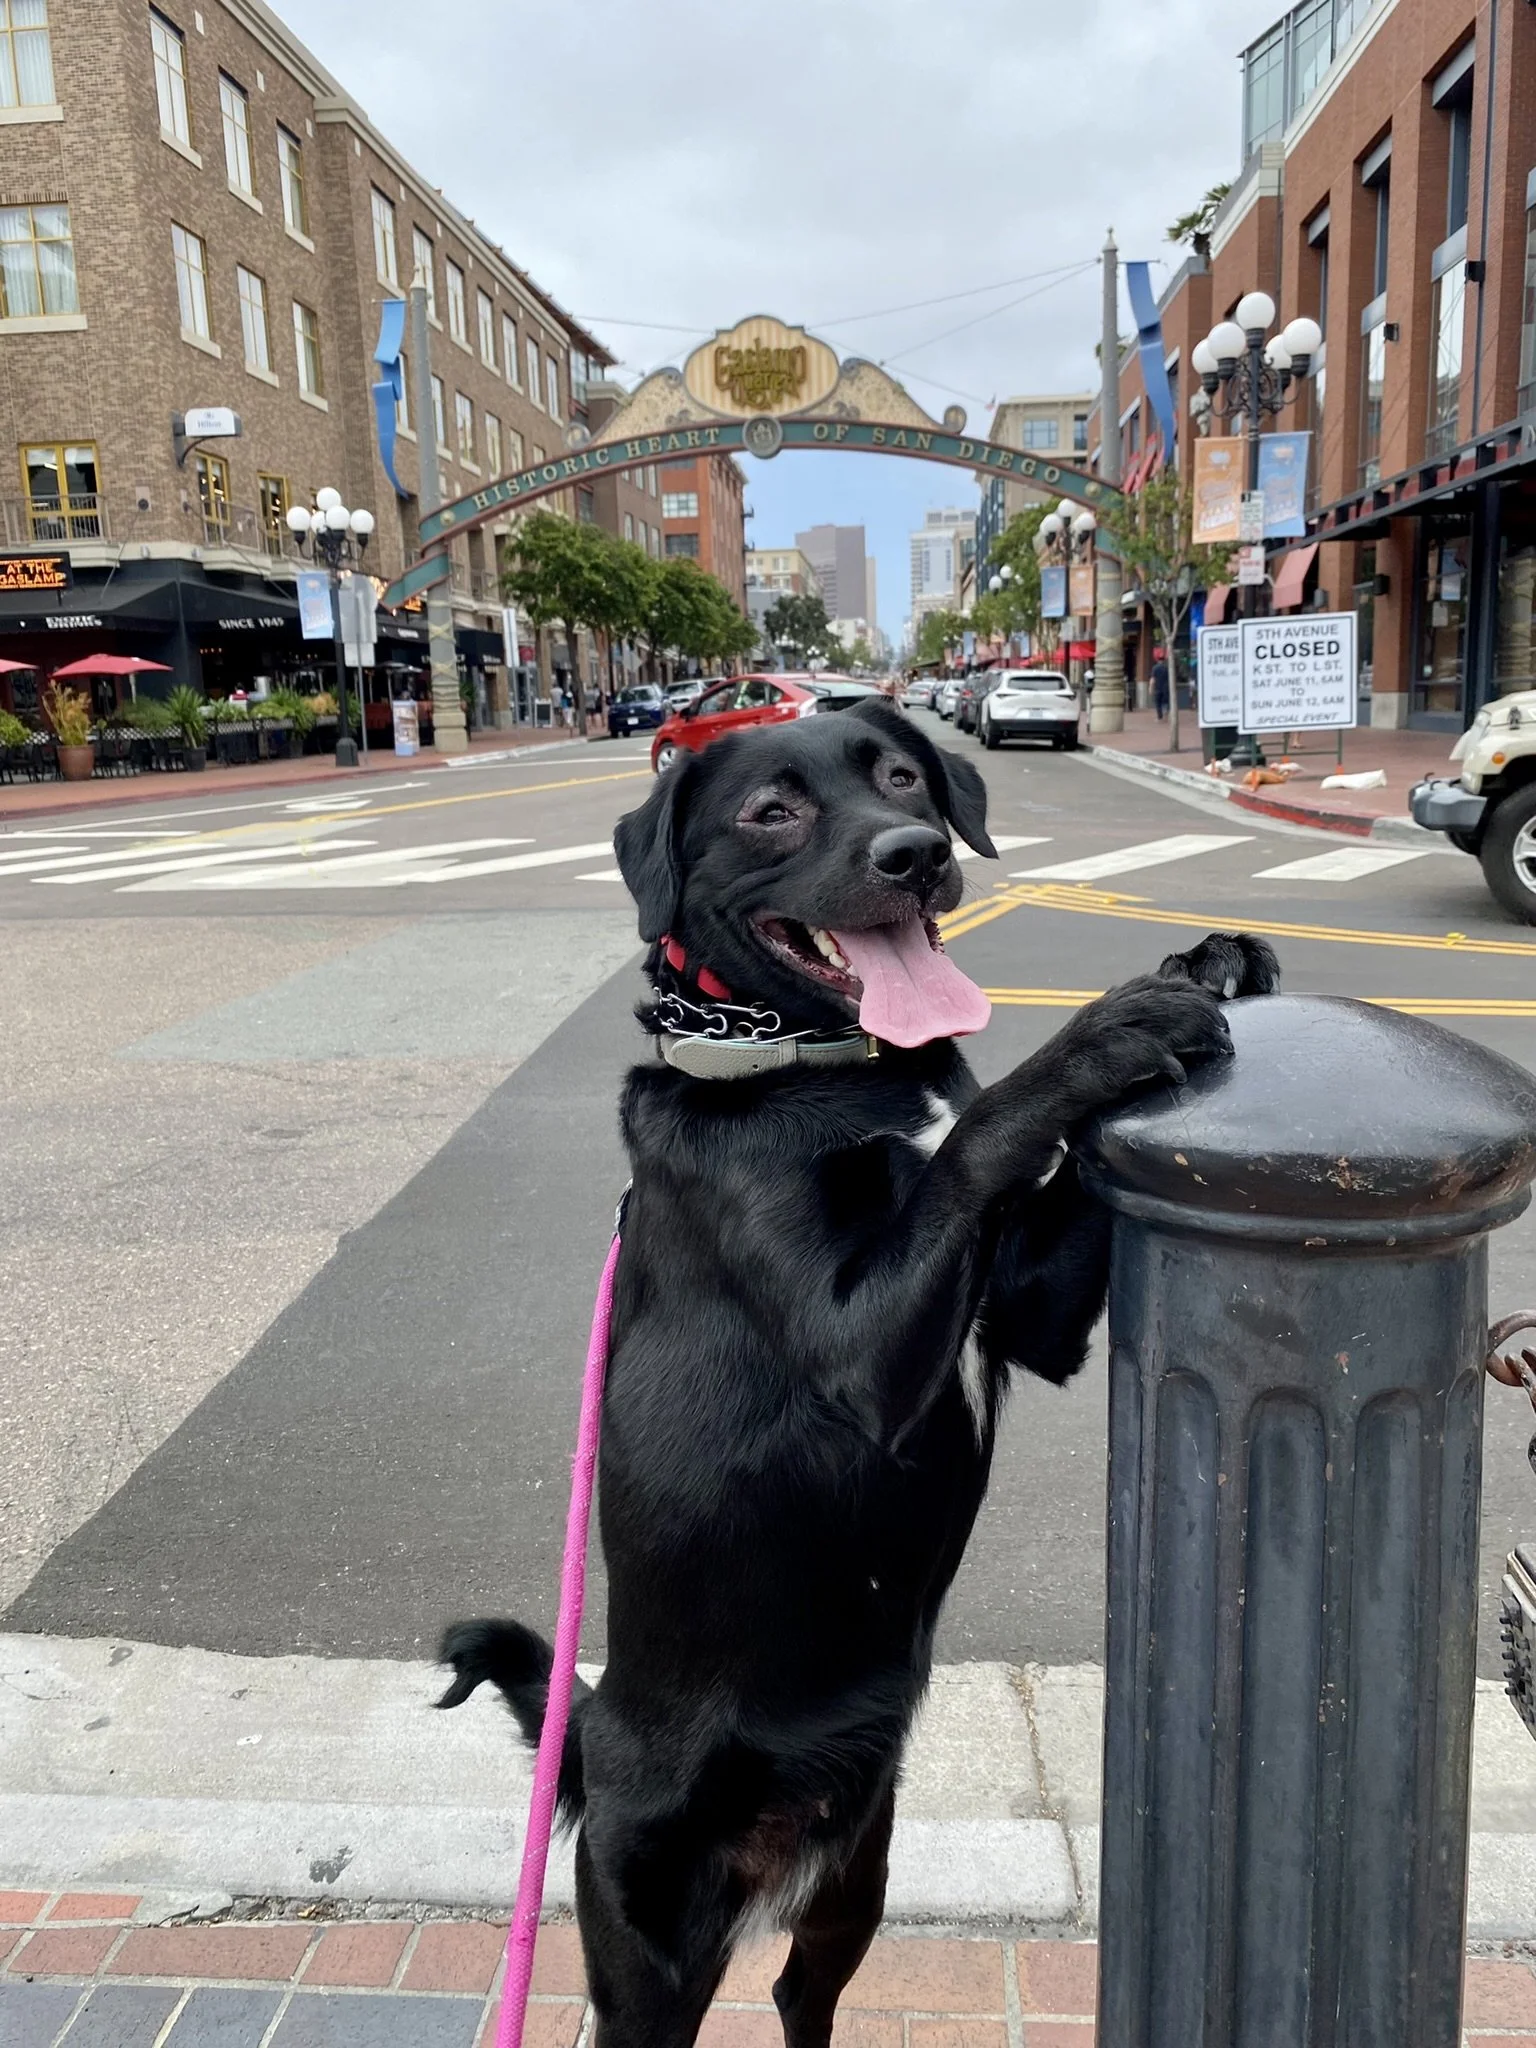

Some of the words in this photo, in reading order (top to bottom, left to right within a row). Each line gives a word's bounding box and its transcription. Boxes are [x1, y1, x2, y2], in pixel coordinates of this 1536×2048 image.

[473, 448, 610, 510] HISTORIC
[624, 427, 720, 458] HEART
[813, 423, 849, 441] OF
[872, 427, 934, 450] SAN
[957, 441, 1061, 484] DIEGO
[7, 563, 22, 574] AT
[26, 561, 53, 574] THE
[0, 572, 66, 585] GASLAMP
[218, 618, 255, 629] SINCE
[1256, 628, 1281, 640] 5TH
[1284, 624, 1339, 638] AVENUE
[1255, 640, 1340, 660] CLOSED
[1252, 665, 1262, 675] K
[1265, 663, 1282, 675] ST.
[1290, 662, 1307, 673] TO
[1313, 661, 1321, 671] L
[1324, 660, 1342, 671] ST.
[1252, 679, 1271, 689] SAT
[1274, 676, 1301, 688] JUNE
[1290, 687, 1305, 697] TO
[1250, 700, 1273, 711] SUN
[1275, 698, 1302, 709] JUNE
[1256, 714, 1299, 725] SPECIAL
[1302, 712, 1339, 723] EVENT
